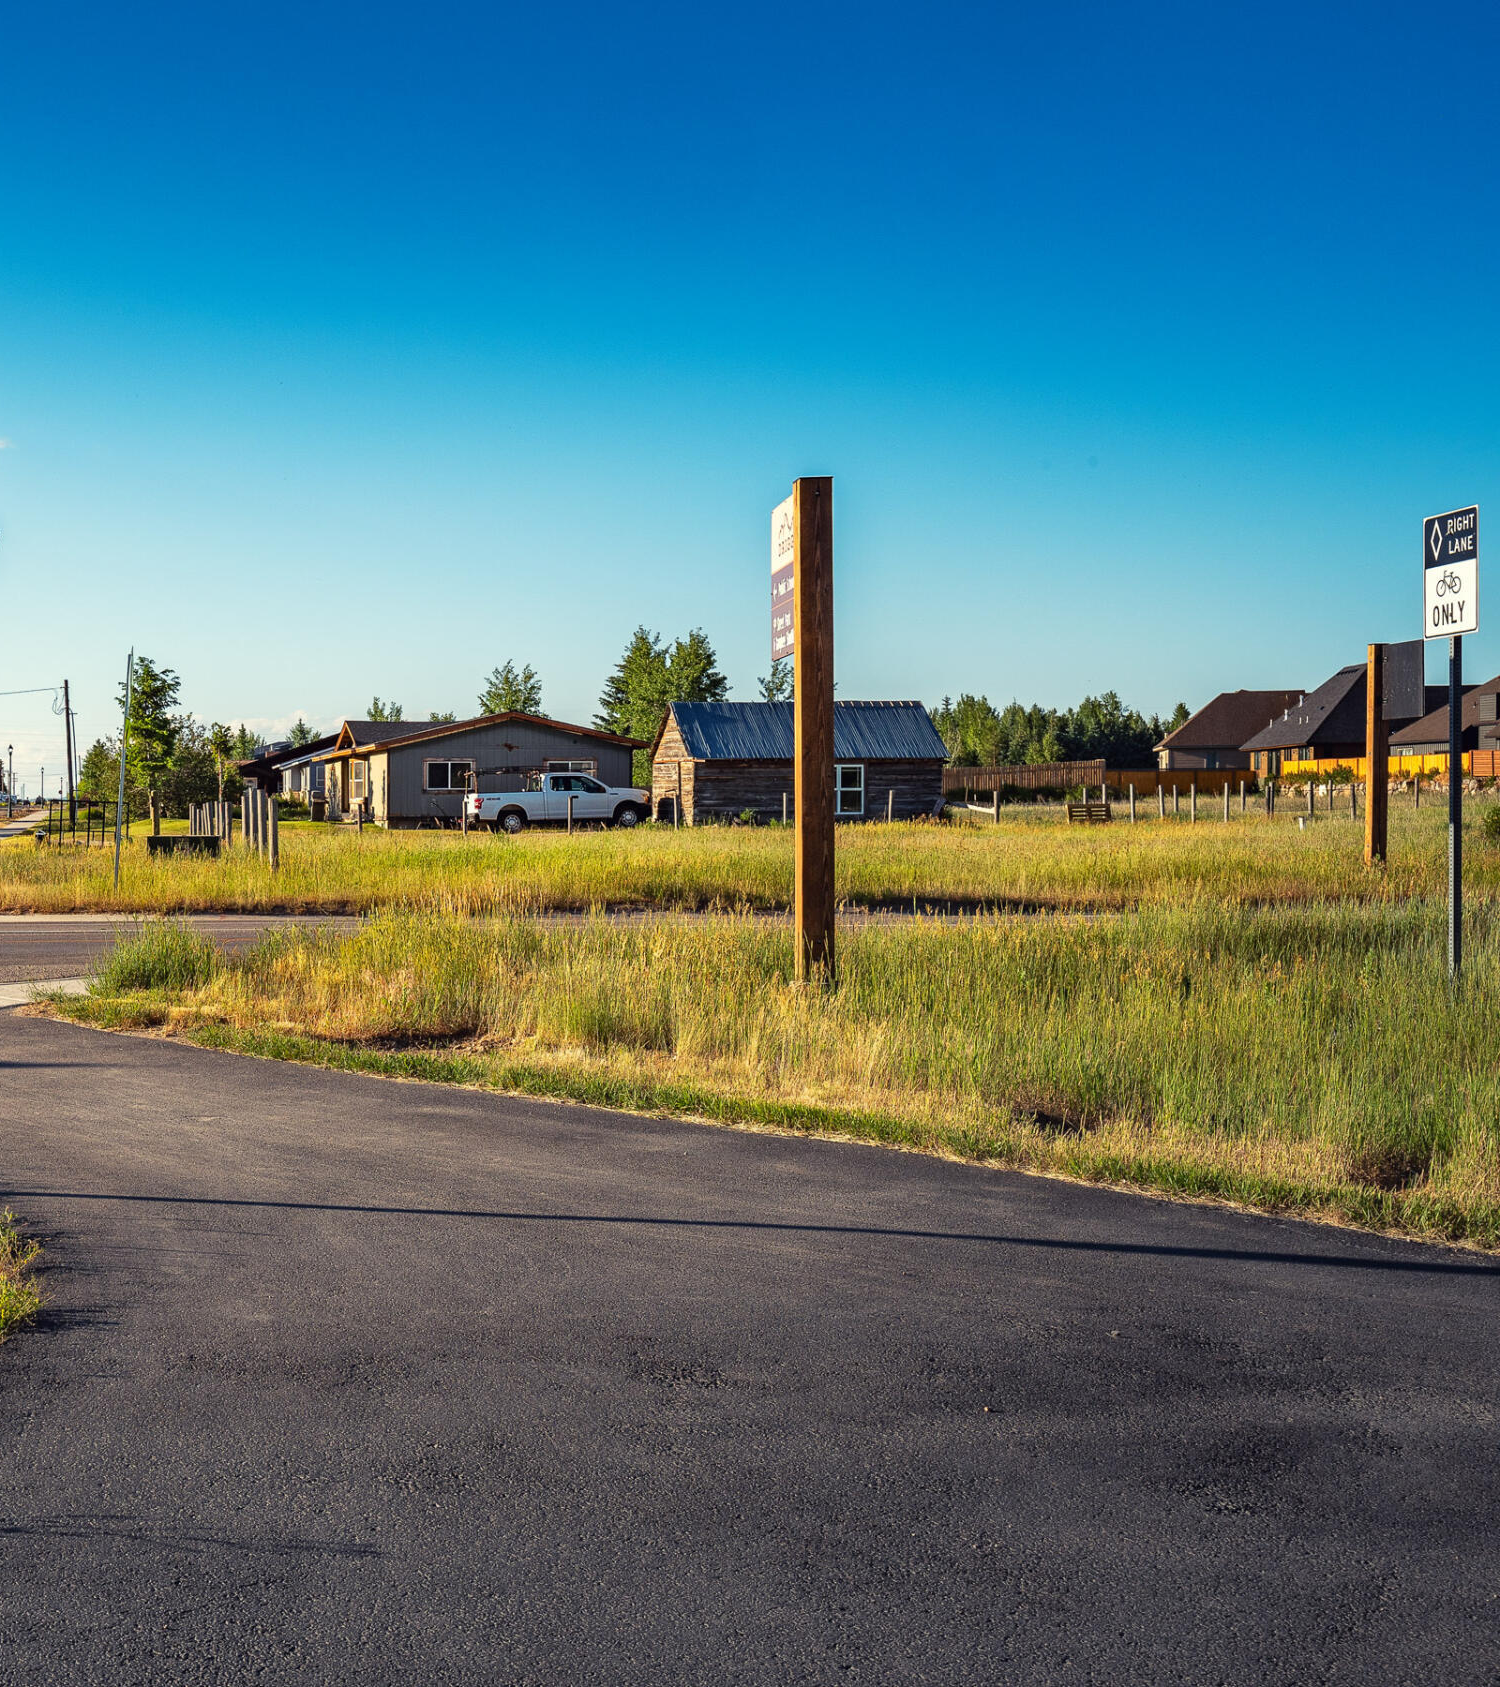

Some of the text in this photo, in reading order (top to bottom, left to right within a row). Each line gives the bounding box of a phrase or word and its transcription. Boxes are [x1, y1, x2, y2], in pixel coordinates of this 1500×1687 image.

[1446, 513, 1475, 536] RIGHT
[1448, 534, 1474, 555] LANE
[1433, 600, 1466, 627] ONLY
